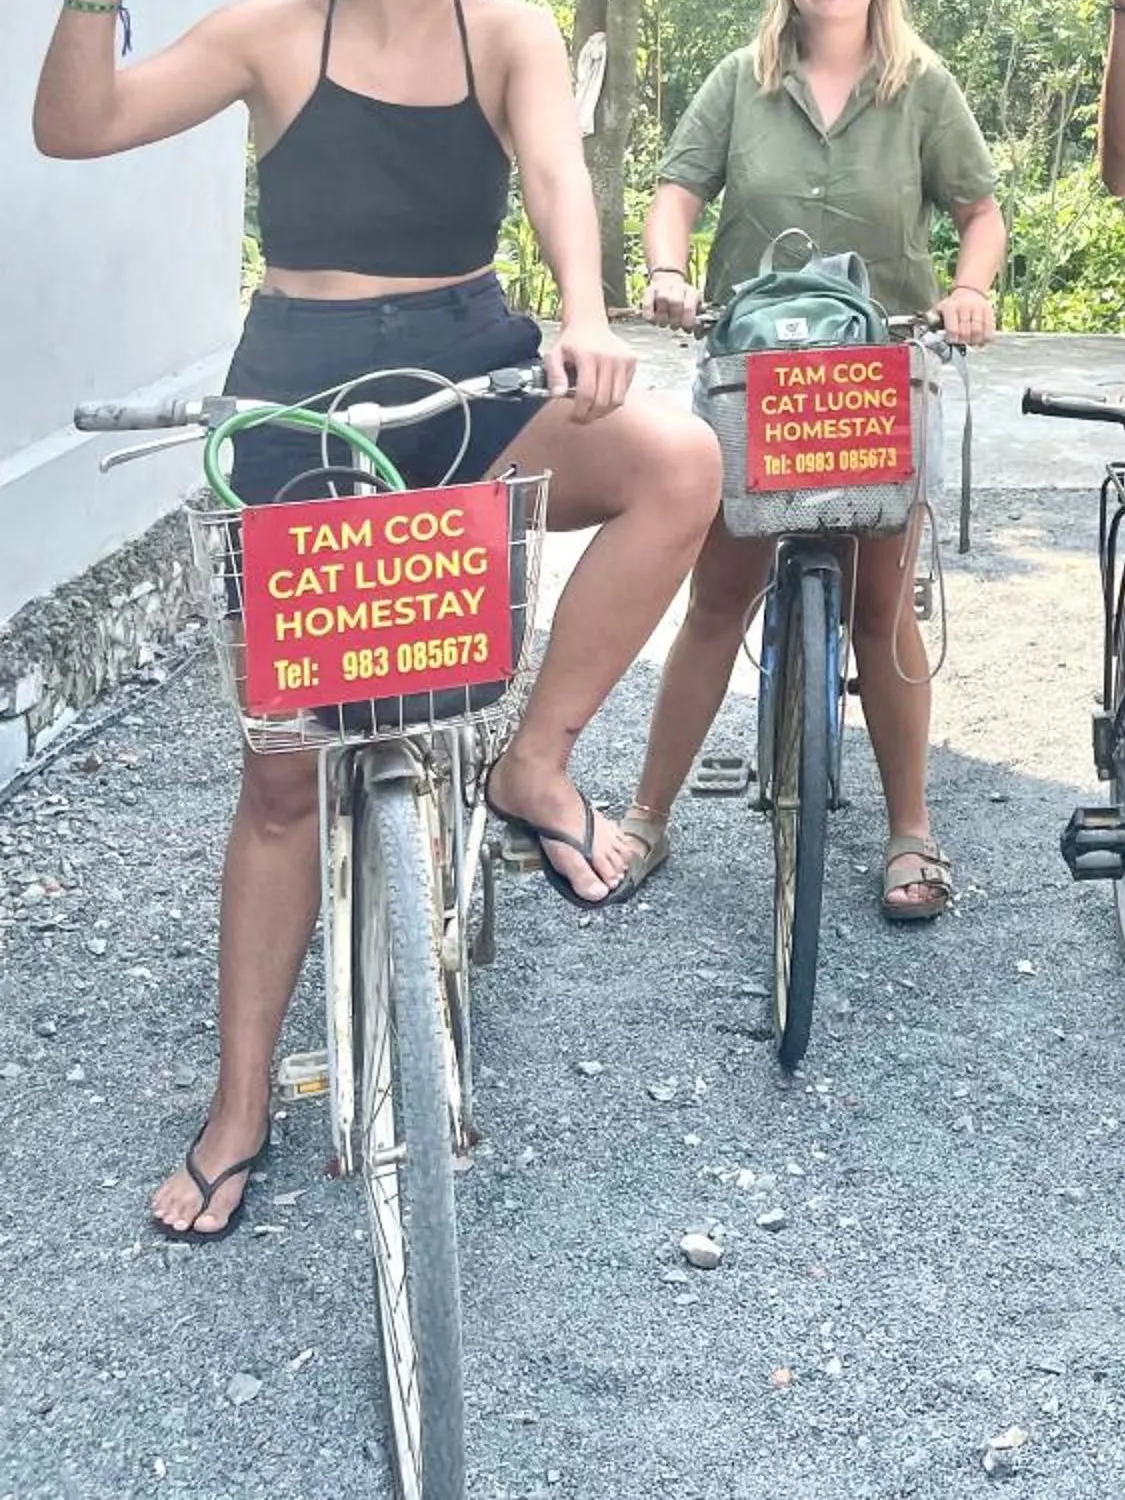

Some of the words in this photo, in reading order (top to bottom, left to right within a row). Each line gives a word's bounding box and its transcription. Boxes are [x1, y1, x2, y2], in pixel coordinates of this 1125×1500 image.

[774, 364, 826, 387] TAM
[832, 361, 883, 384] COC
[761, 393, 808, 415] CAT
[815, 387, 897, 412] LUONG
[765, 416, 895, 443] HOMESTAY
[763, 454, 792, 476] Tel:
[795, 451, 835, 474] 0983
[839, 447, 897, 471] 085673
[289, 519, 372, 555] TAM
[384, 508, 465, 545] COC
[268, 563, 344, 599] CAT
[355, 546, 488, 589] LUONG
[276, 586, 485, 641] HOMESTAY
[273, 657, 319, 690] Tel:
[396, 632, 488, 673] 085673
